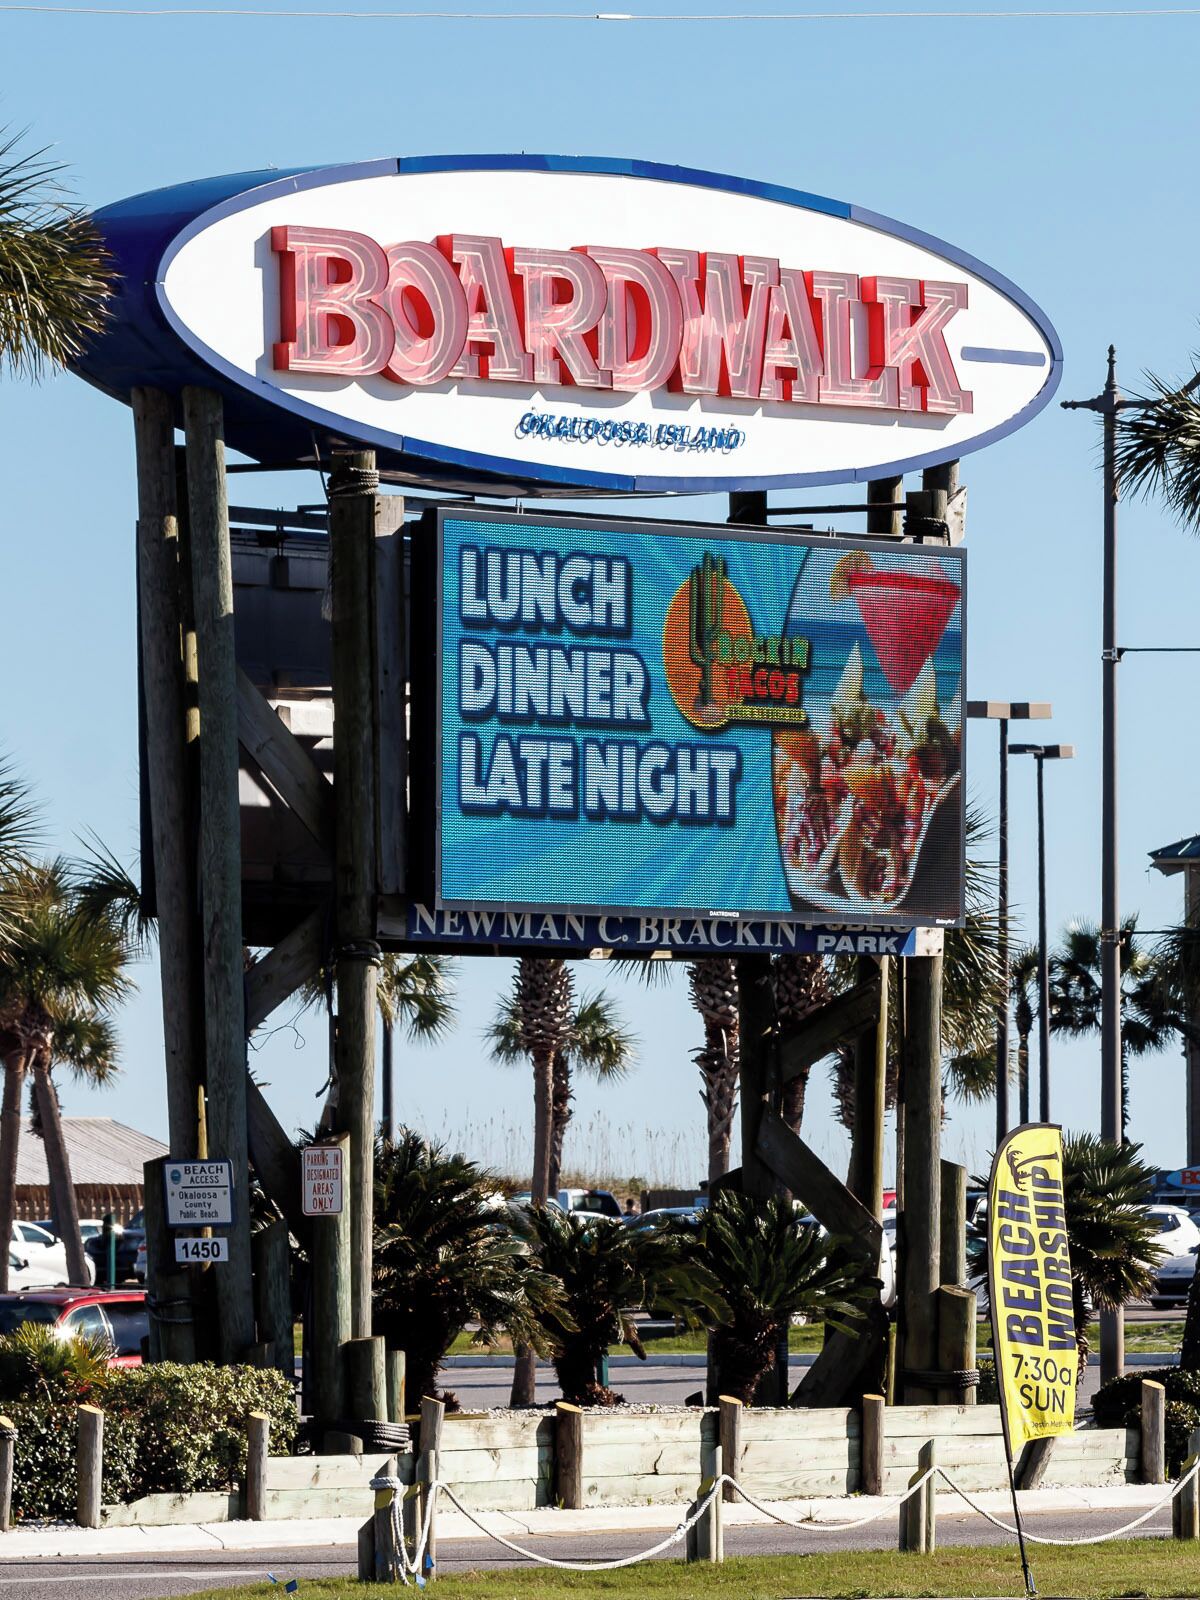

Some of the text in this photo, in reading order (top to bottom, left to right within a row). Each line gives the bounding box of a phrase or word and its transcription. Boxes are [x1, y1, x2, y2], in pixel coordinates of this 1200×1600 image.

[272, 224, 973, 413] BOARDWALK
[654, 423, 745, 449] ISLAND
[461, 549, 627, 628] LUNCH
[460, 643, 648, 720] DINNER
[726, 667, 799, 703] TACOS
[460, 737, 737, 817] LATE NIGHT
[412, 903, 797, 948] NEWMAN C. BRACKIN
[816, 934, 898, 953] PARK
[184, 1165, 223, 1174] BEACH
[190, 1175, 219, 1184] ACCESS
[178, 1191, 217, 1200] Okaloosa
[312, 1182, 334, 1195] AREAS
[179, 1209, 218, 1219] Public Beach
[184, 1201, 212, 1209] County
[312, 1197, 334, 1210] ONLY
[182, 1241, 220, 1258] 1450
[1031, 1166, 1076, 1350] WORSHIP
[998, 1189, 1044, 1346] BEACH
[1011, 1353, 1072, 1386] 7:30a
[1020, 1383, 1066, 1414] SUN
